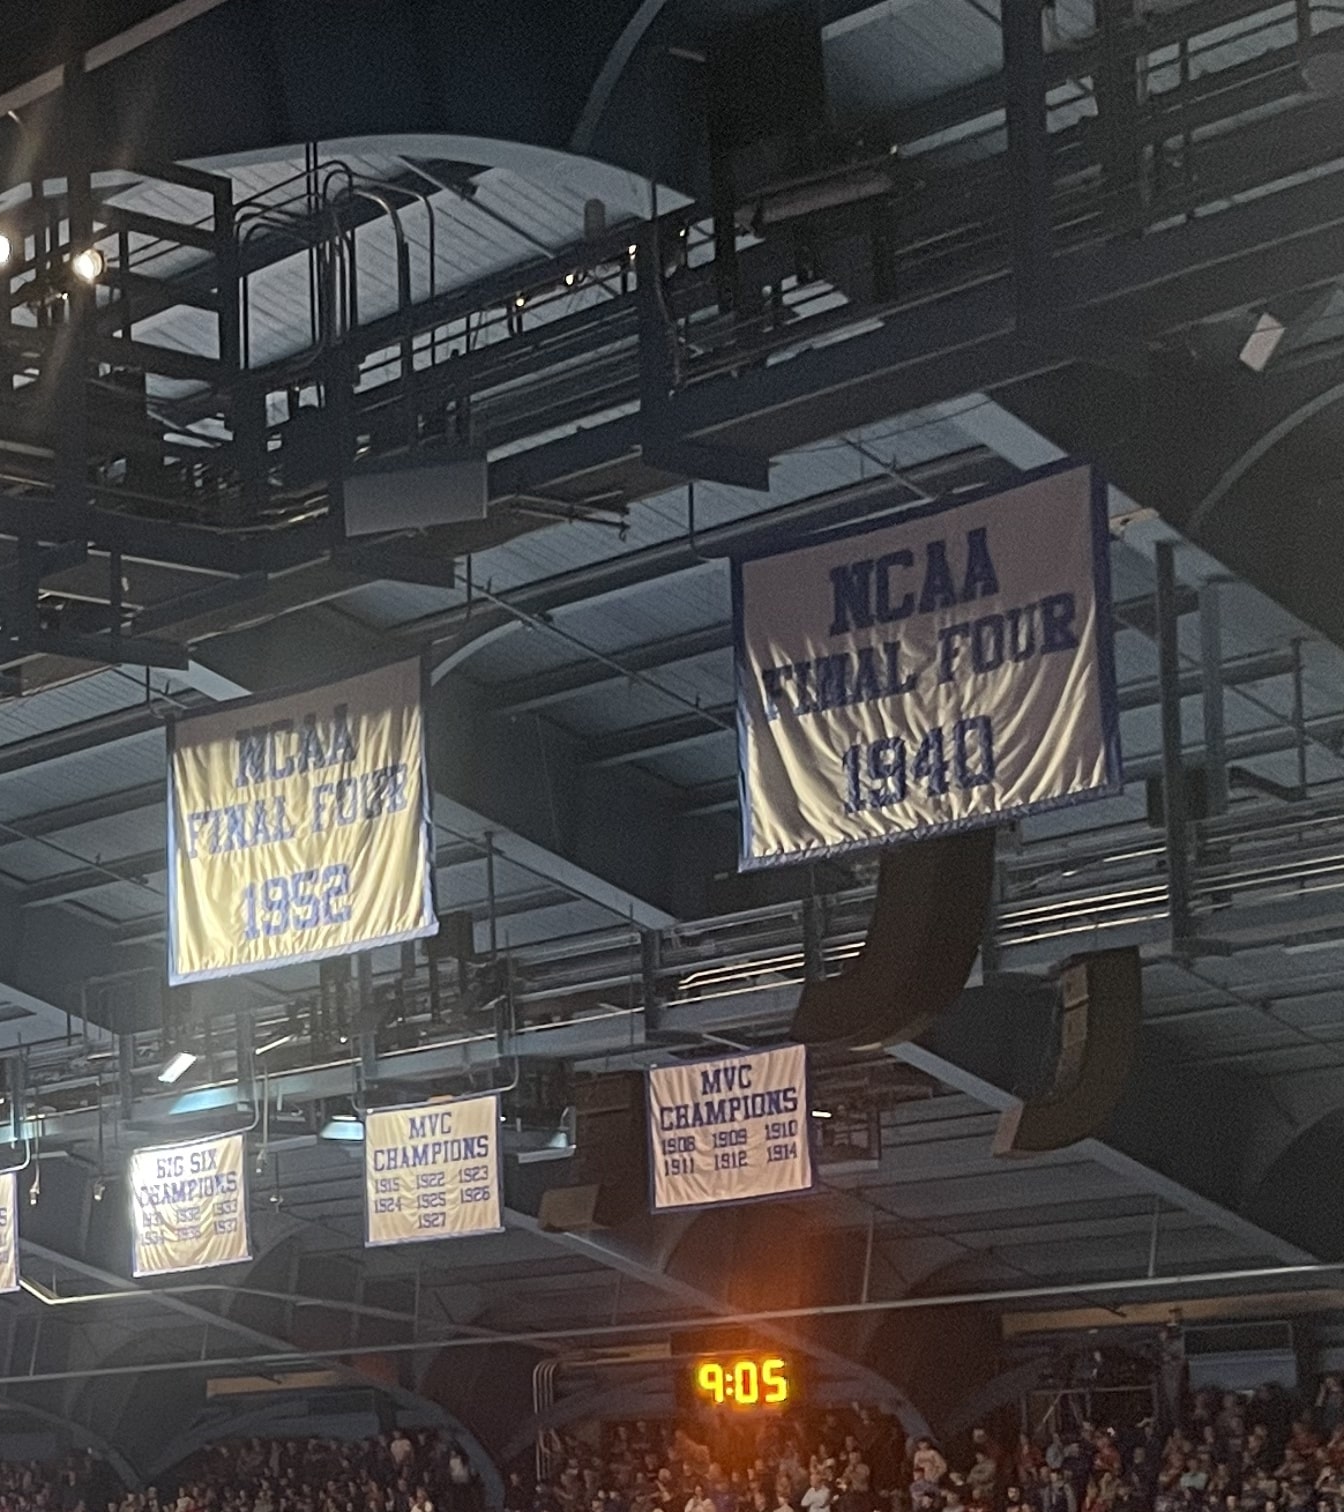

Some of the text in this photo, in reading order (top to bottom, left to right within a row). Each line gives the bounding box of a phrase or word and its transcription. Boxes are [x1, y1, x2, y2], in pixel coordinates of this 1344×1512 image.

[829, 526, 999, 637] NCAA
[762, 592, 1080, 724] FINAL FOUR
[235, 702, 358, 788] NCAA
[842, 714, 996, 813] 1940
[187, 762, 409, 859] FINAL FOUR
[242, 863, 353, 941] 1952
[700, 1064, 753, 1096] MVC
[408, 1111, 452, 1140] MVC
[659, 1087, 798, 1132] CHAMPIONS
[373, 1134, 490, 1172] CHAMPIONS
[712, 1129, 748, 1150] 1909
[764, 1119, 799, 1141] 1910
[156, 1148, 218, 1180] BIG SIX
[415, 1171, 445, 1189] 1922
[458, 1164, 489, 1184] 1923
[664, 1142, 798, 1177] 1911 1912 1914
[138, 1170, 238, 1208] CHAMPIONS
[374, 1196, 402, 1214] 1924
[416, 1191, 446, 1209] 1925
[417, 1211, 446, 1229] 1927
[698, 1358, 788, 1404] 9:05
